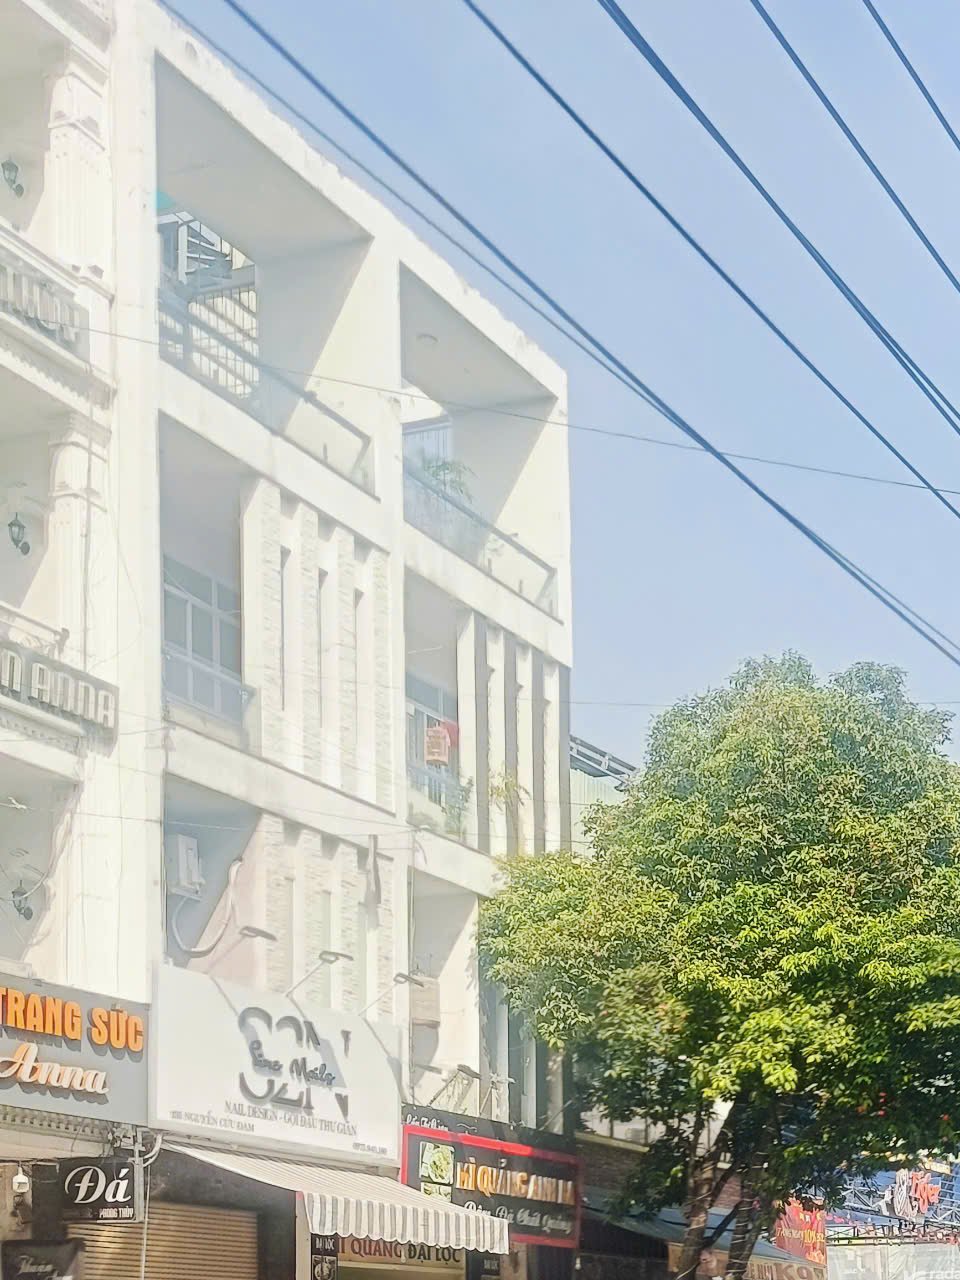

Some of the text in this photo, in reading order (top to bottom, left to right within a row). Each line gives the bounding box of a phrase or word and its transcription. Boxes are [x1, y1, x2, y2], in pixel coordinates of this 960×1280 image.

[91, 1002, 144, 1052] SỨC
[0, 1042, 109, 1095] Anna
[224, 1100, 246, 1117] NAIL
[247, 1104, 278, 1122] DESIGN
[65, 1165, 132, 1204] Đá
